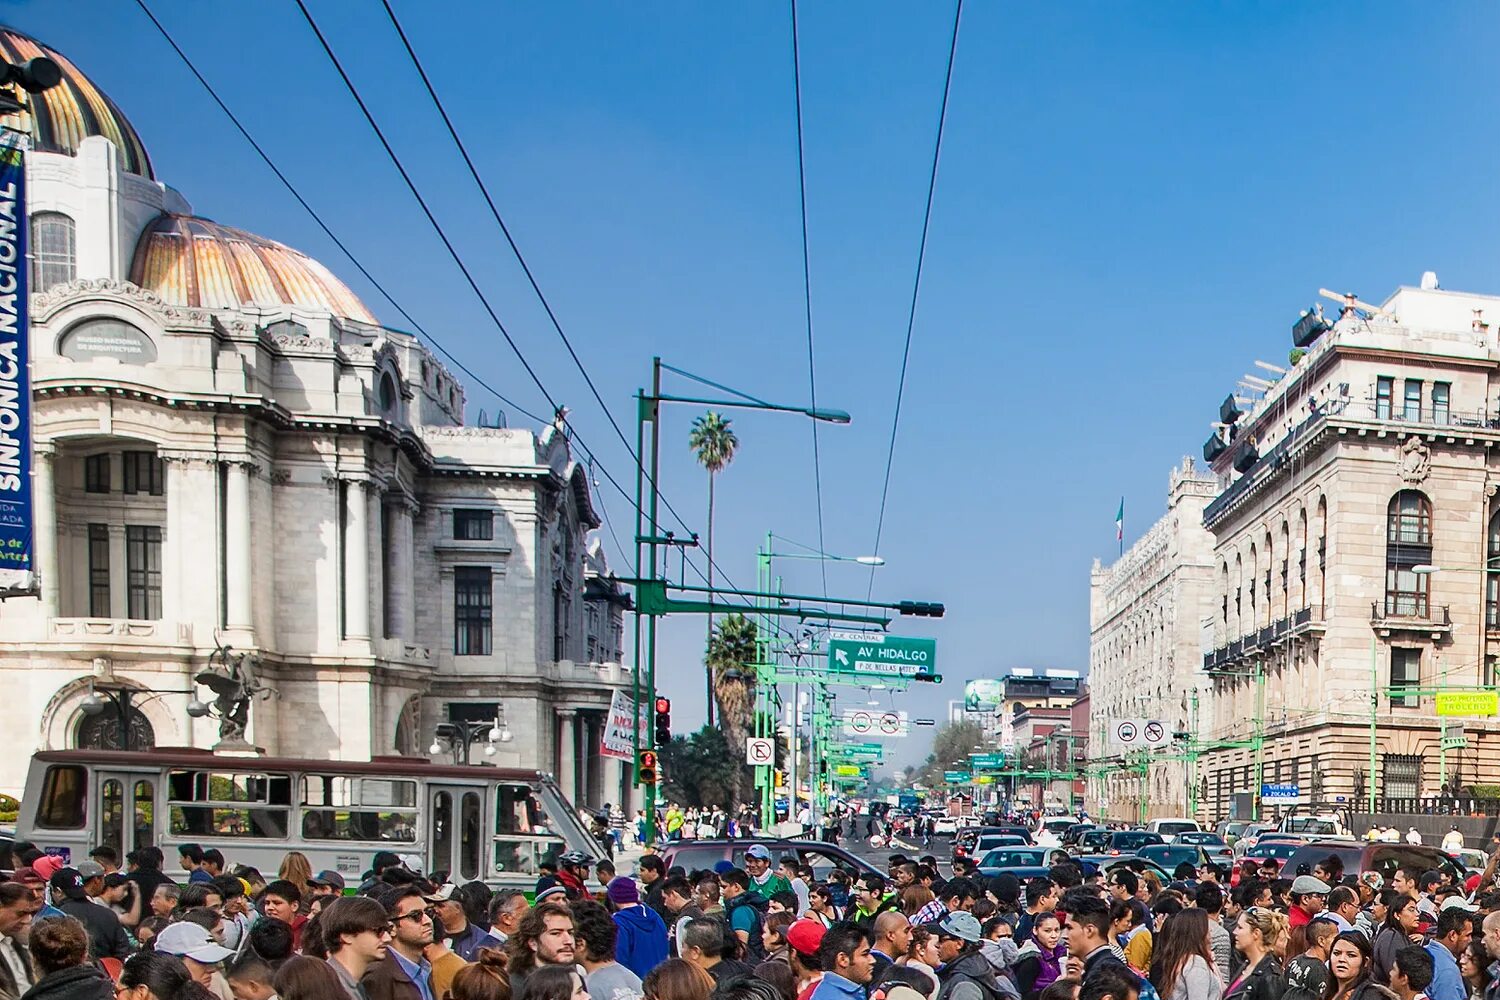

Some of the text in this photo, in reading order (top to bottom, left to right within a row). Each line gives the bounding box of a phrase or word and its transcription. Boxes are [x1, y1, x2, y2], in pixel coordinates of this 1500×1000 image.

[0, 182, 18, 334] NACIONAL
[8, 538, 23, 548] de
[858, 646, 928, 661] AV HIDALGO
[875, 664, 897, 672] BELLAS
